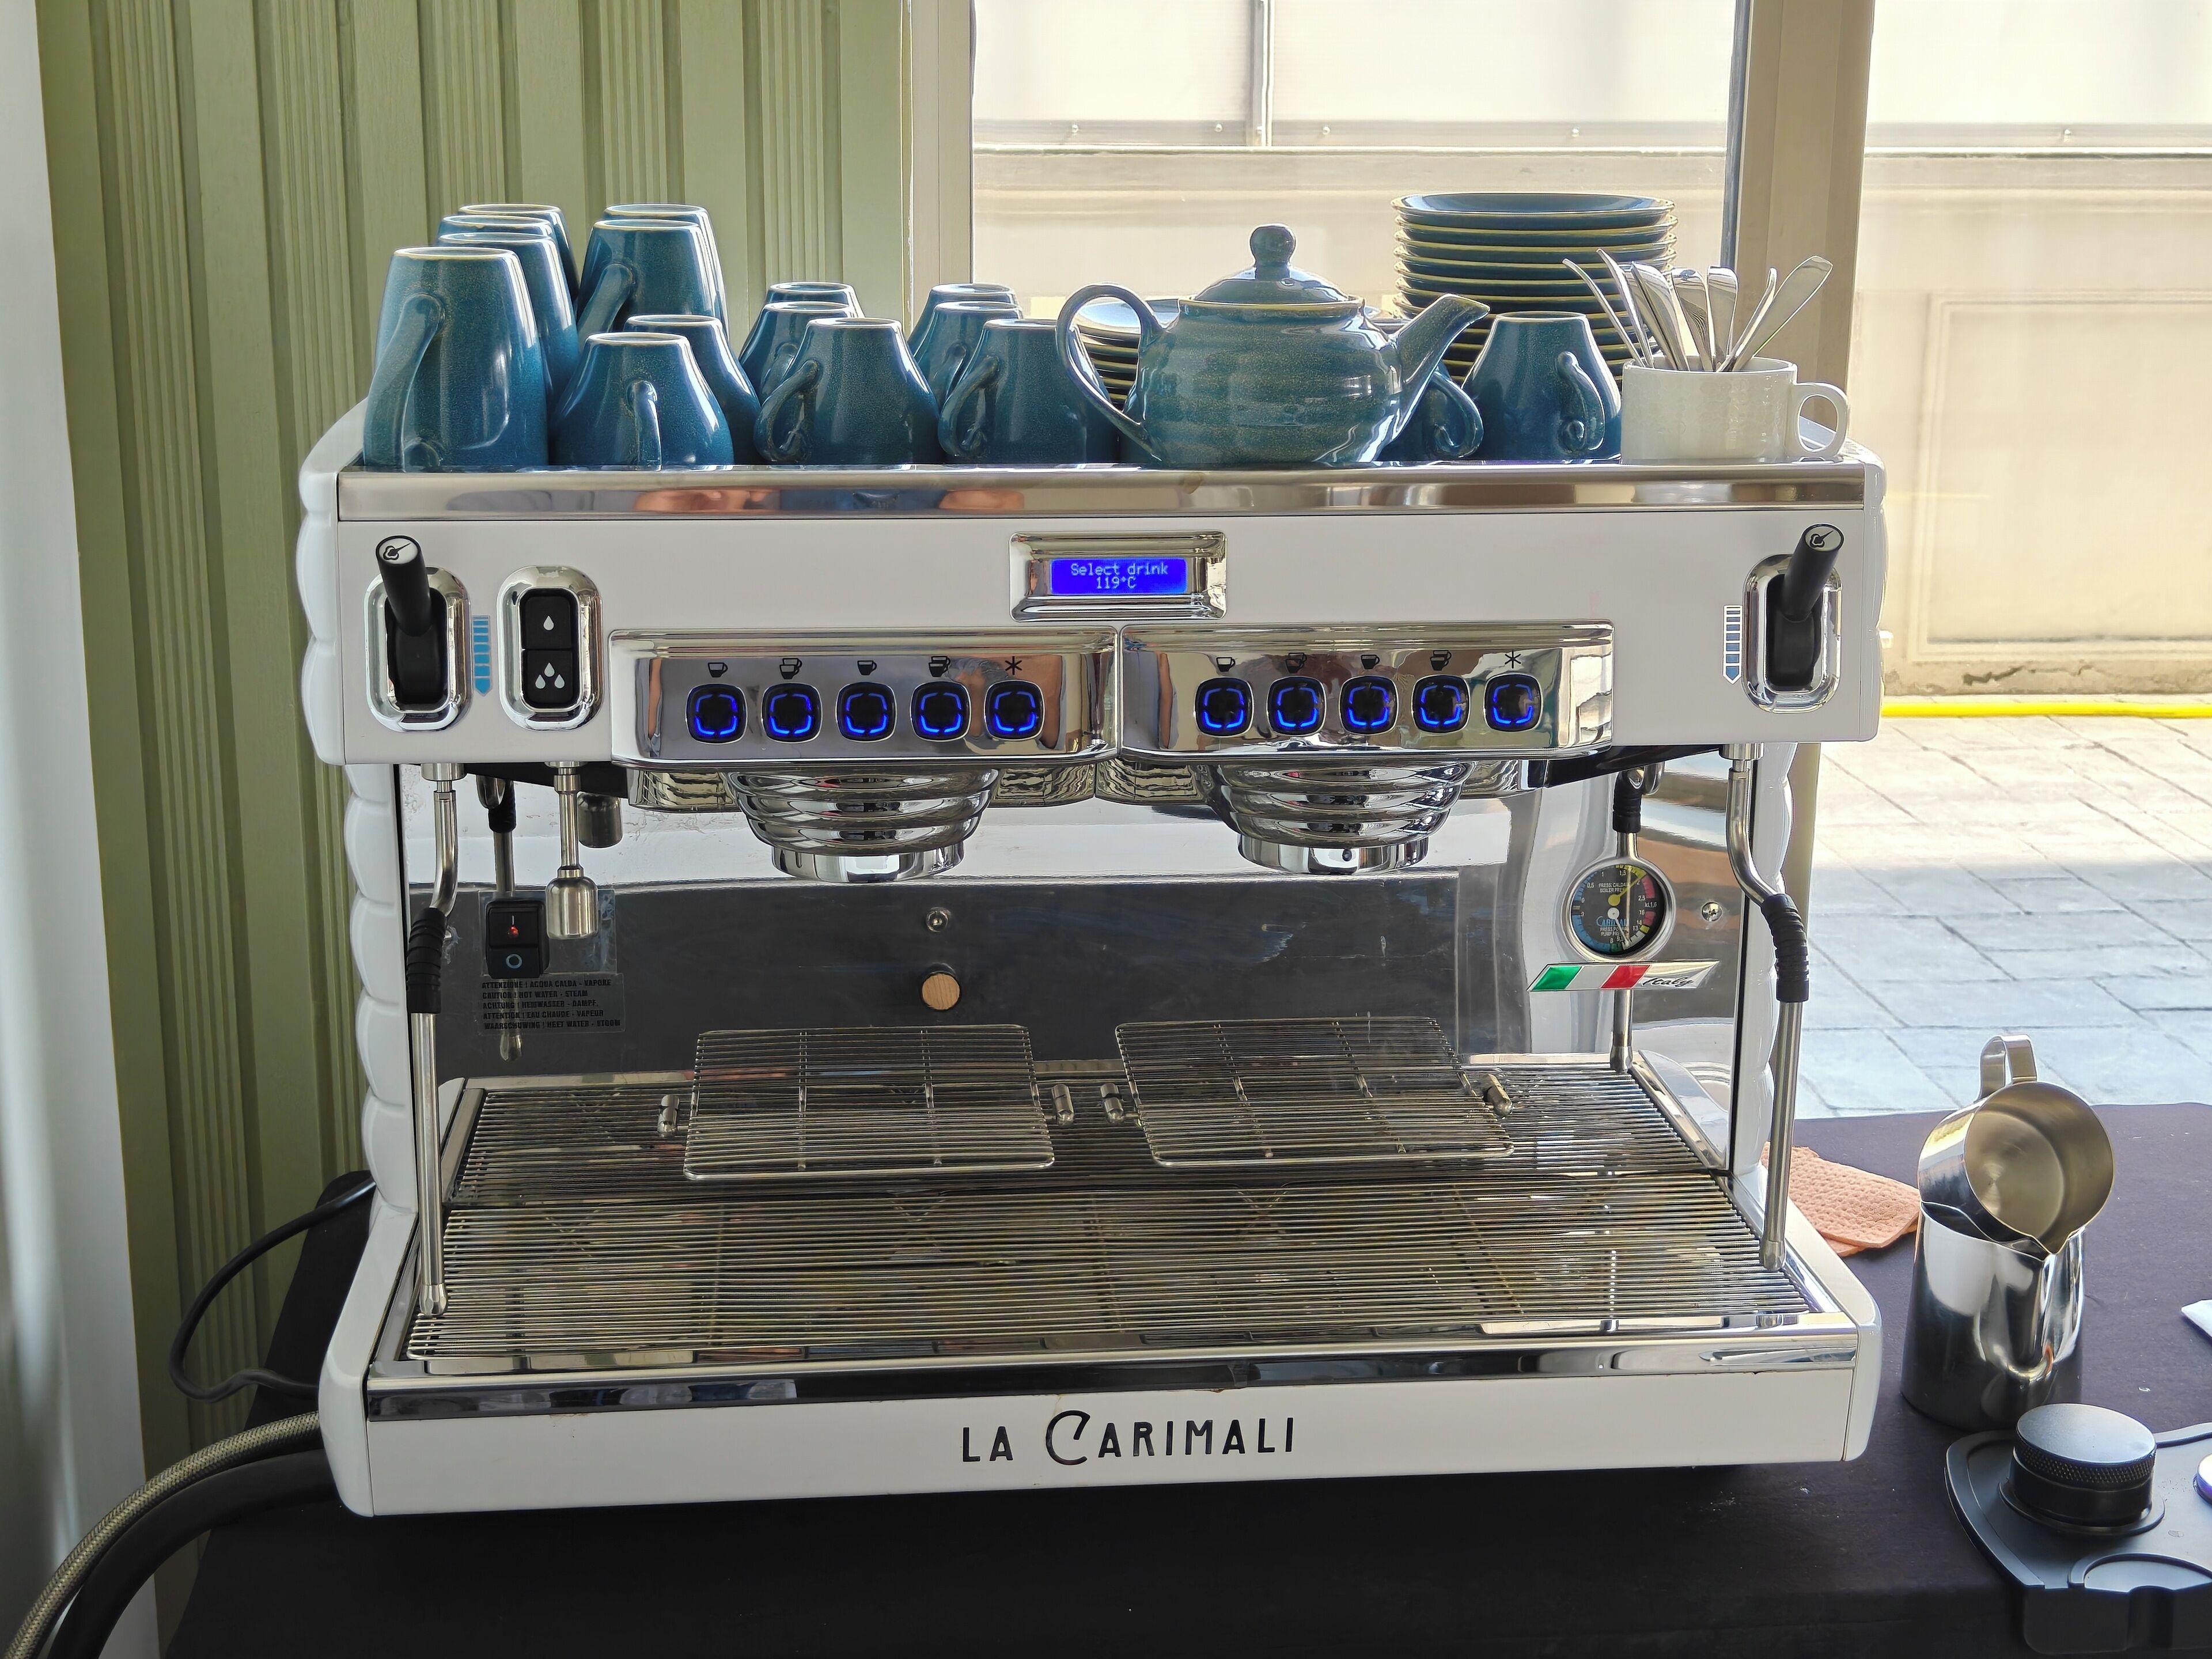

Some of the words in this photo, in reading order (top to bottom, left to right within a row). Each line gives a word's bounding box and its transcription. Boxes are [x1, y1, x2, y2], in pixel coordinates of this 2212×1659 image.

[1070, 563, 1120, 576] Select
[1127, 563, 1168, 575] drink
[1096, 577, 1137, 589] 119°C
[1642, 977, 1694, 987] Italy
[962, 1426, 1014, 1463] LA
[1046, 1410, 1294, 1465] CARIMALI
